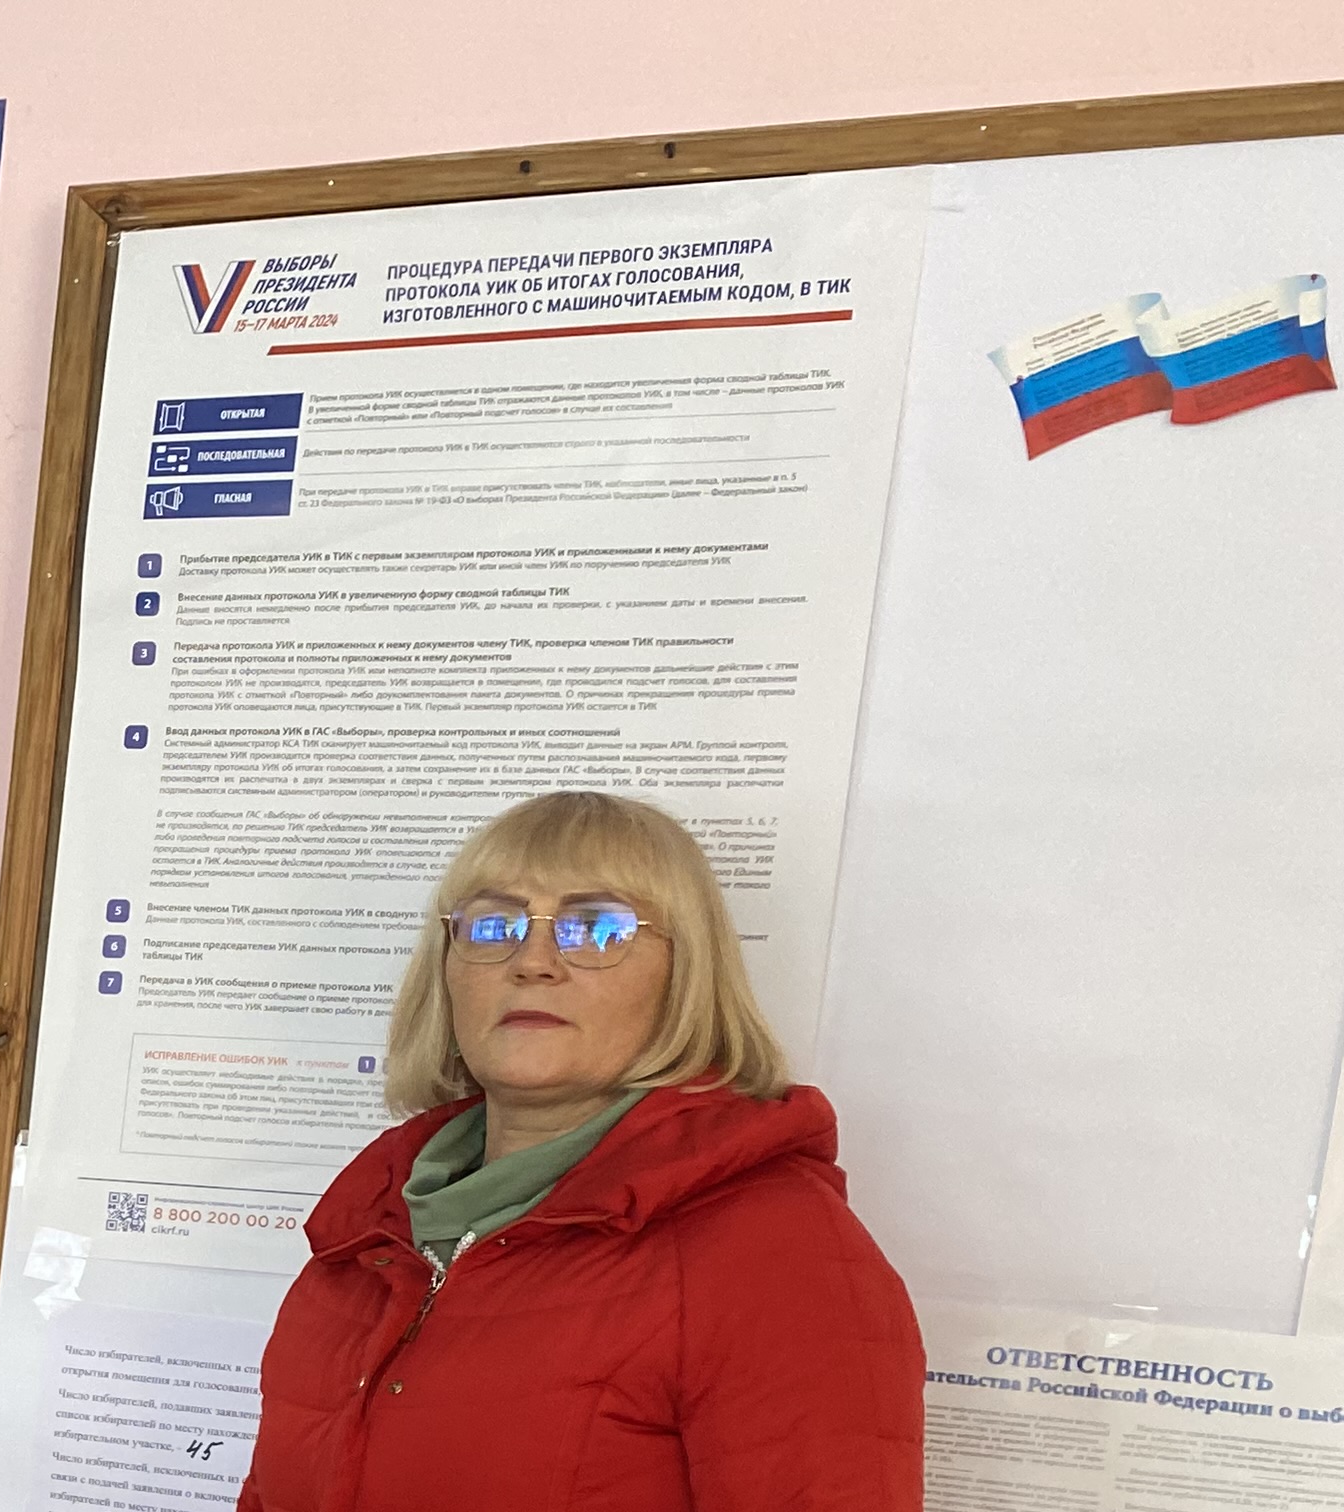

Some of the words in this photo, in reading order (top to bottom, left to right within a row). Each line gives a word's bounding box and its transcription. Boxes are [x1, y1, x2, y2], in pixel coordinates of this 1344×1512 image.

[262, 253, 338, 274] ВЫБОРЫ
[387, 259, 484, 281] ПРОЦЕДУРА
[487, 252, 575, 274] ПЕРЕДАЧИ
[578, 246, 654, 267] ПЕРВОГО
[658, 237, 773, 261] ЭКЗЕМПЛЯРА
[252, 272, 358, 294] ПРЕЗИДЕНТА
[385, 281, 481, 303] ПРОТОКОЛА
[486, 279, 518, 296] УИК
[521, 277, 543, 293] ОБ
[546, 272, 613, 291] ИТОГАХ
[615, 262, 744, 286] ГОЛОСОВАНИЯ,
[242, 296, 310, 314] РОССИИ
[382, 300, 528, 324] ИЗГОТОВЛЕННОГО
[532, 299, 543, 314] С
[546, 286, 723, 313] МАШИНОЧИТАЕМЫМ
[726, 282, 795, 303] КОДОМ,
[799, 281, 812, 297] В
[816, 277, 852, 295] ТИК
[267, 316, 309, 330] МАРТА
[309, 314, 339, 328] 2024
[220, 408, 265, 420] ОТКРЫТАЯ
[197, 448, 285, 461] ПОСЛЕДОВАТЕЛЬНАЯ
[214, 492, 252, 504] ГЛАСНАЯ
[146, 560, 152, 570] 1
[143, 599, 151, 609] 2
[140, 648, 148, 658] 3
[132, 732, 140, 742] 4
[114, 906, 121, 915] 5
[111, 942, 118, 951] 6
[107, 978, 114, 988] 7
[144, 1050, 217, 1063] ИСПРАВЛЕНИЕ
[219, 1053, 265, 1065] ОШИБОК
[267, 1055, 288, 1066] УИК
[153, 1207, 163, 1220] 8
[168, 1209, 202, 1223] 800
[207, 1211, 241, 1226] 200
[246, 1214, 269, 1228] 00
[275, 1216, 297, 1230] 20
[151, 1225, 190, 1238] cikrf.ru
[987, 1346, 1274, 1391] ОТВЕТСТВЕННОСТЬ
[1027, 1377, 1148, 1404] Российской
[1154, 1389, 1273, 1418] Федерации
[1279, 1406, 1292, 1418] о
[1298, 1407, 1344, 1423] выб
[185, 1440, 223, 1461] 45
